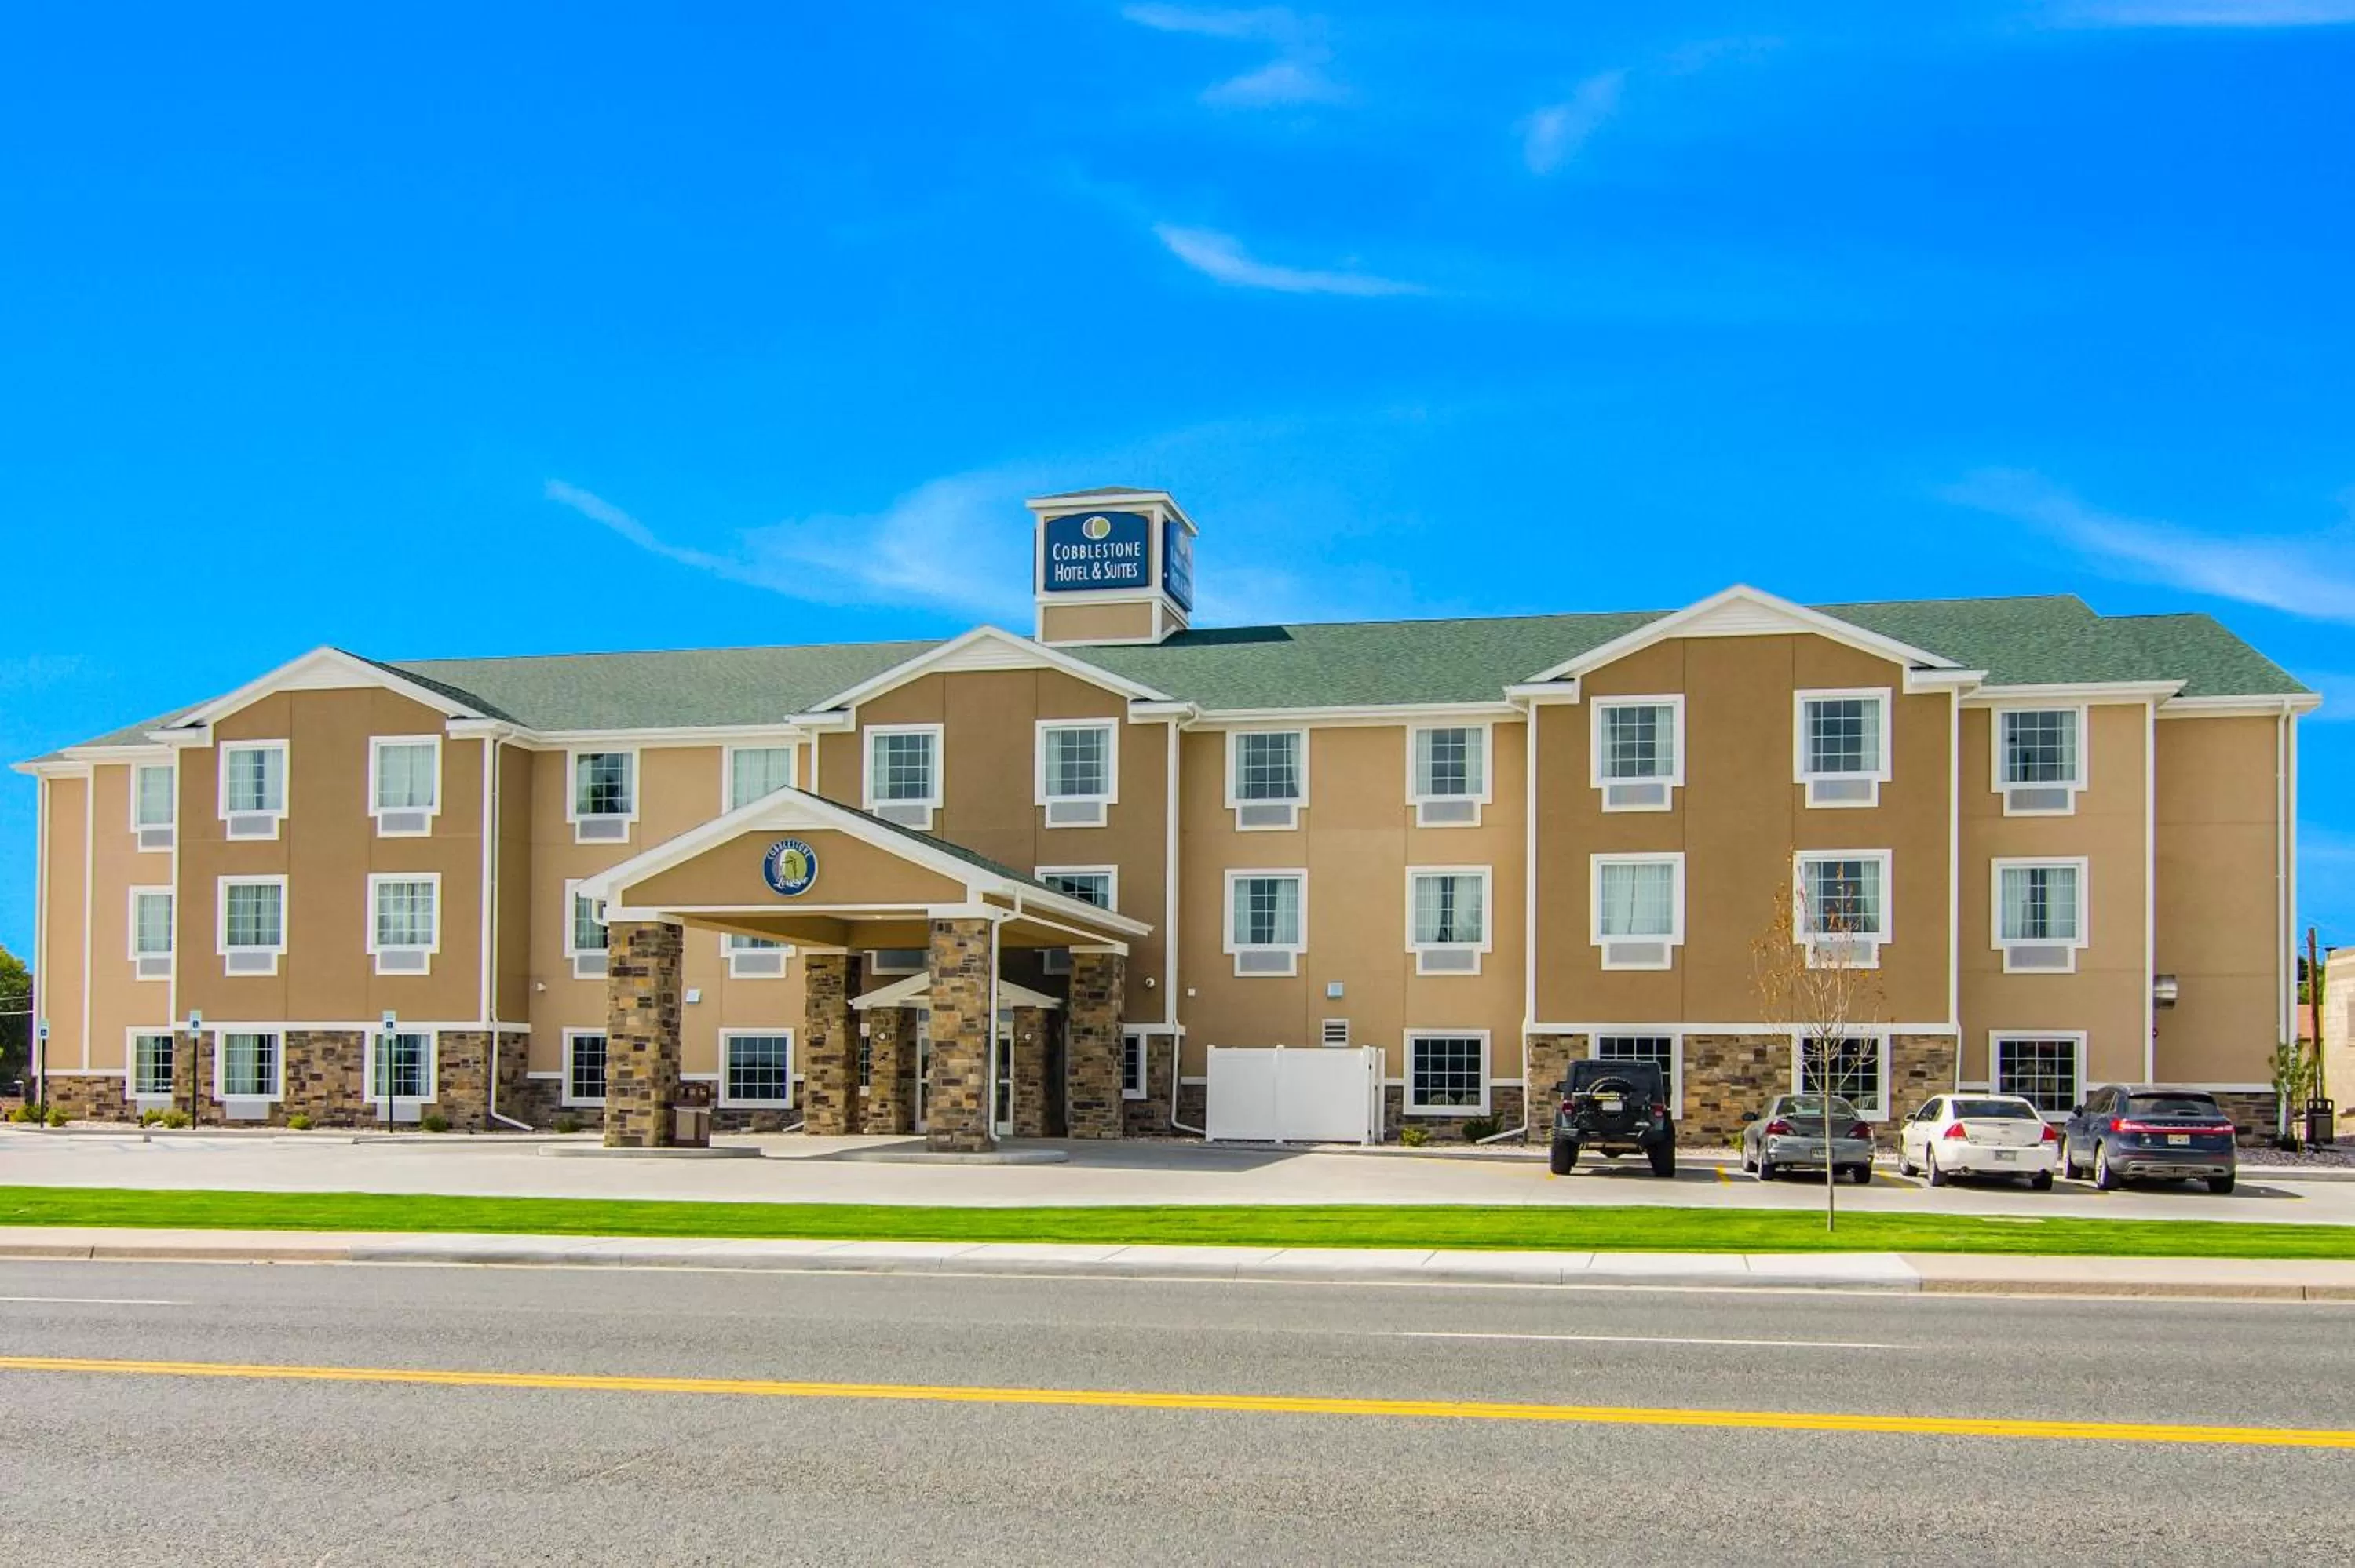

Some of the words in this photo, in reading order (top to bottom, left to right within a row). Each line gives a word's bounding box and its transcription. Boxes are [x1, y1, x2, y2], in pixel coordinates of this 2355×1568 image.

[1053, 542, 1140, 560] COBBLESTONE
[1054, 563, 1089, 582] HOTEL
[1092, 562, 1101, 579] &
[1104, 561, 1137, 578] SUITES
